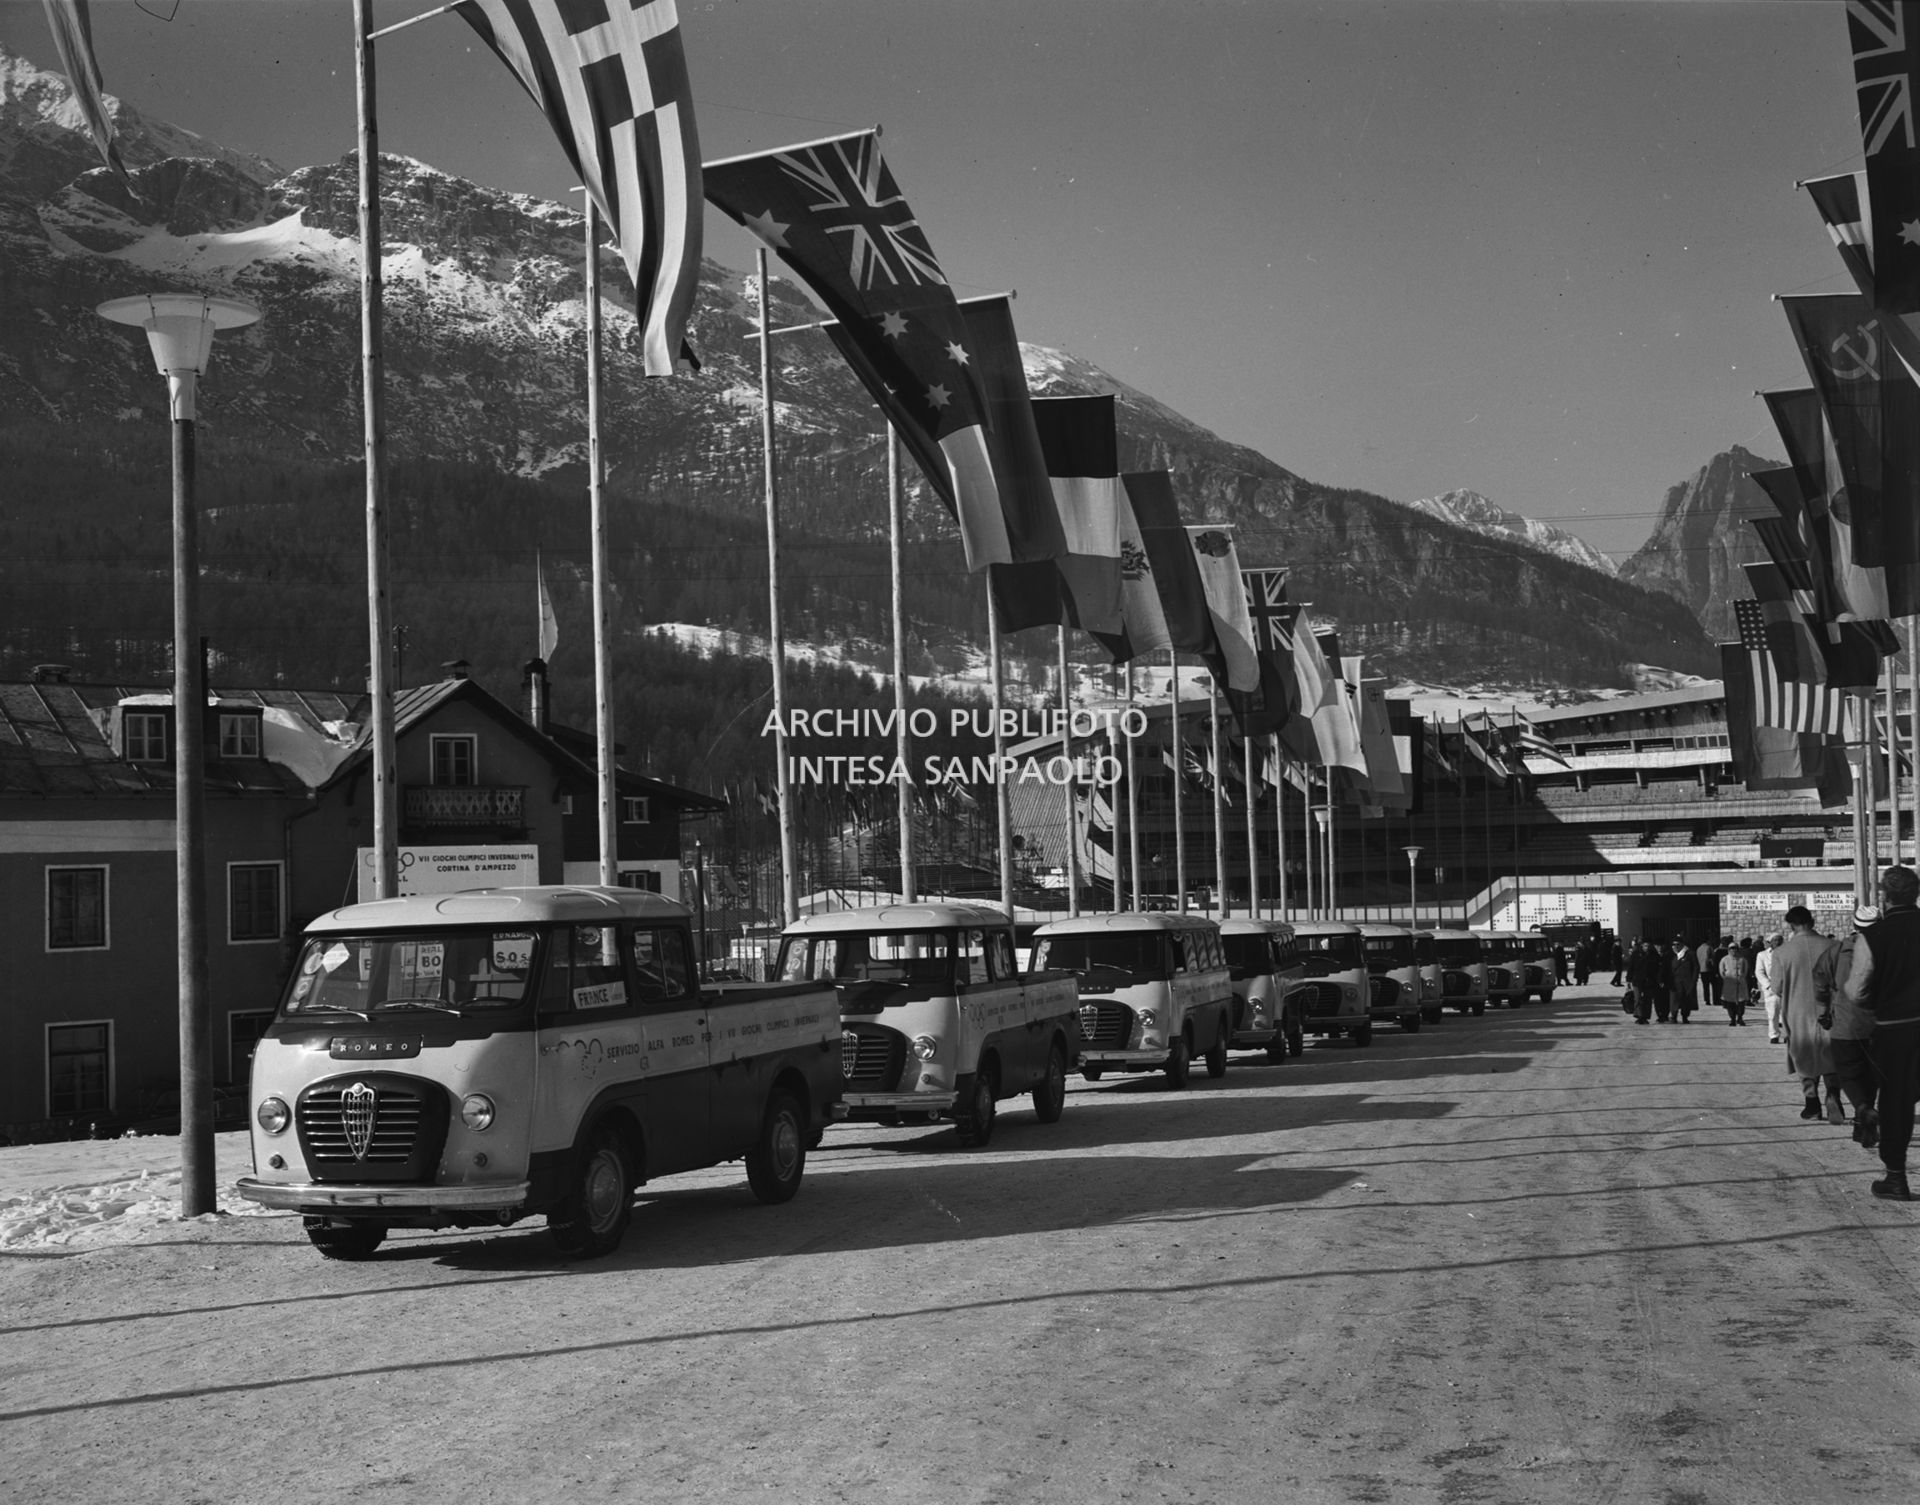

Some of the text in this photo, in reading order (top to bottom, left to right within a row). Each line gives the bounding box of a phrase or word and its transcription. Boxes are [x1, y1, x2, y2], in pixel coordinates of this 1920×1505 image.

[458, 854, 487, 862] OLIMPICI
[488, 853, 520, 861] INVERNALI
[437, 864, 470, 872] CORTINA
[578, 988, 609, 1007] FRANCE
[607, 1043, 640, 1059] SERVIZIO
[648, 1040, 665, 1051] ALFA
[672, 1034, 695, 1047] ROMEO
[741, 1023, 762, 1036] GIOCHI
[340, 1043, 408, 1052] ROMEO
